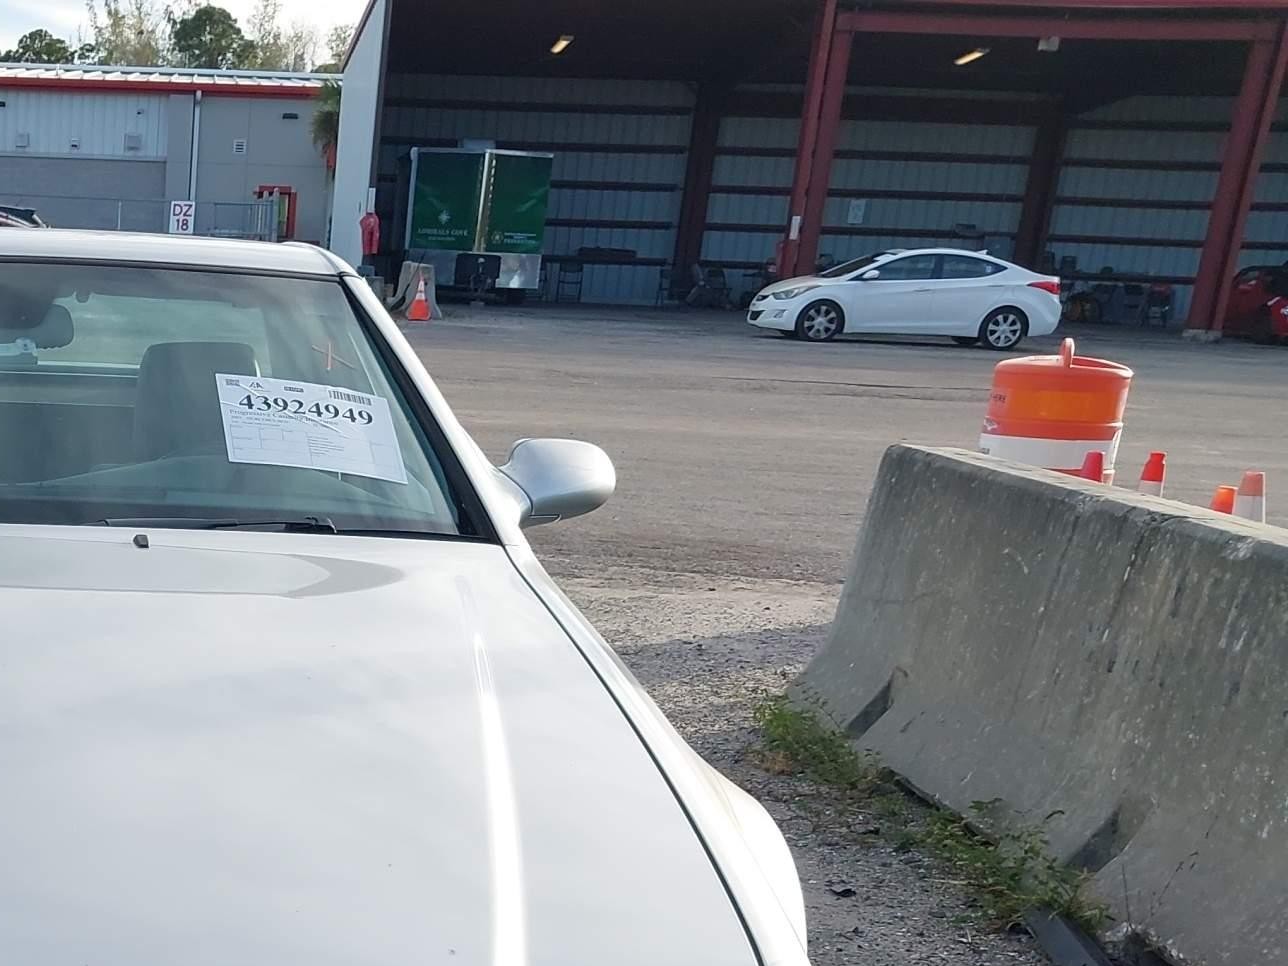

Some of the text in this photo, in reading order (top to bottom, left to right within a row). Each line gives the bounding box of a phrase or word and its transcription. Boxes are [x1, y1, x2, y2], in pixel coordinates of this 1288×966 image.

[173, 203, 193, 217] DZ
[175, 218, 189, 232] 18
[239, 394, 373, 426] 43924949
